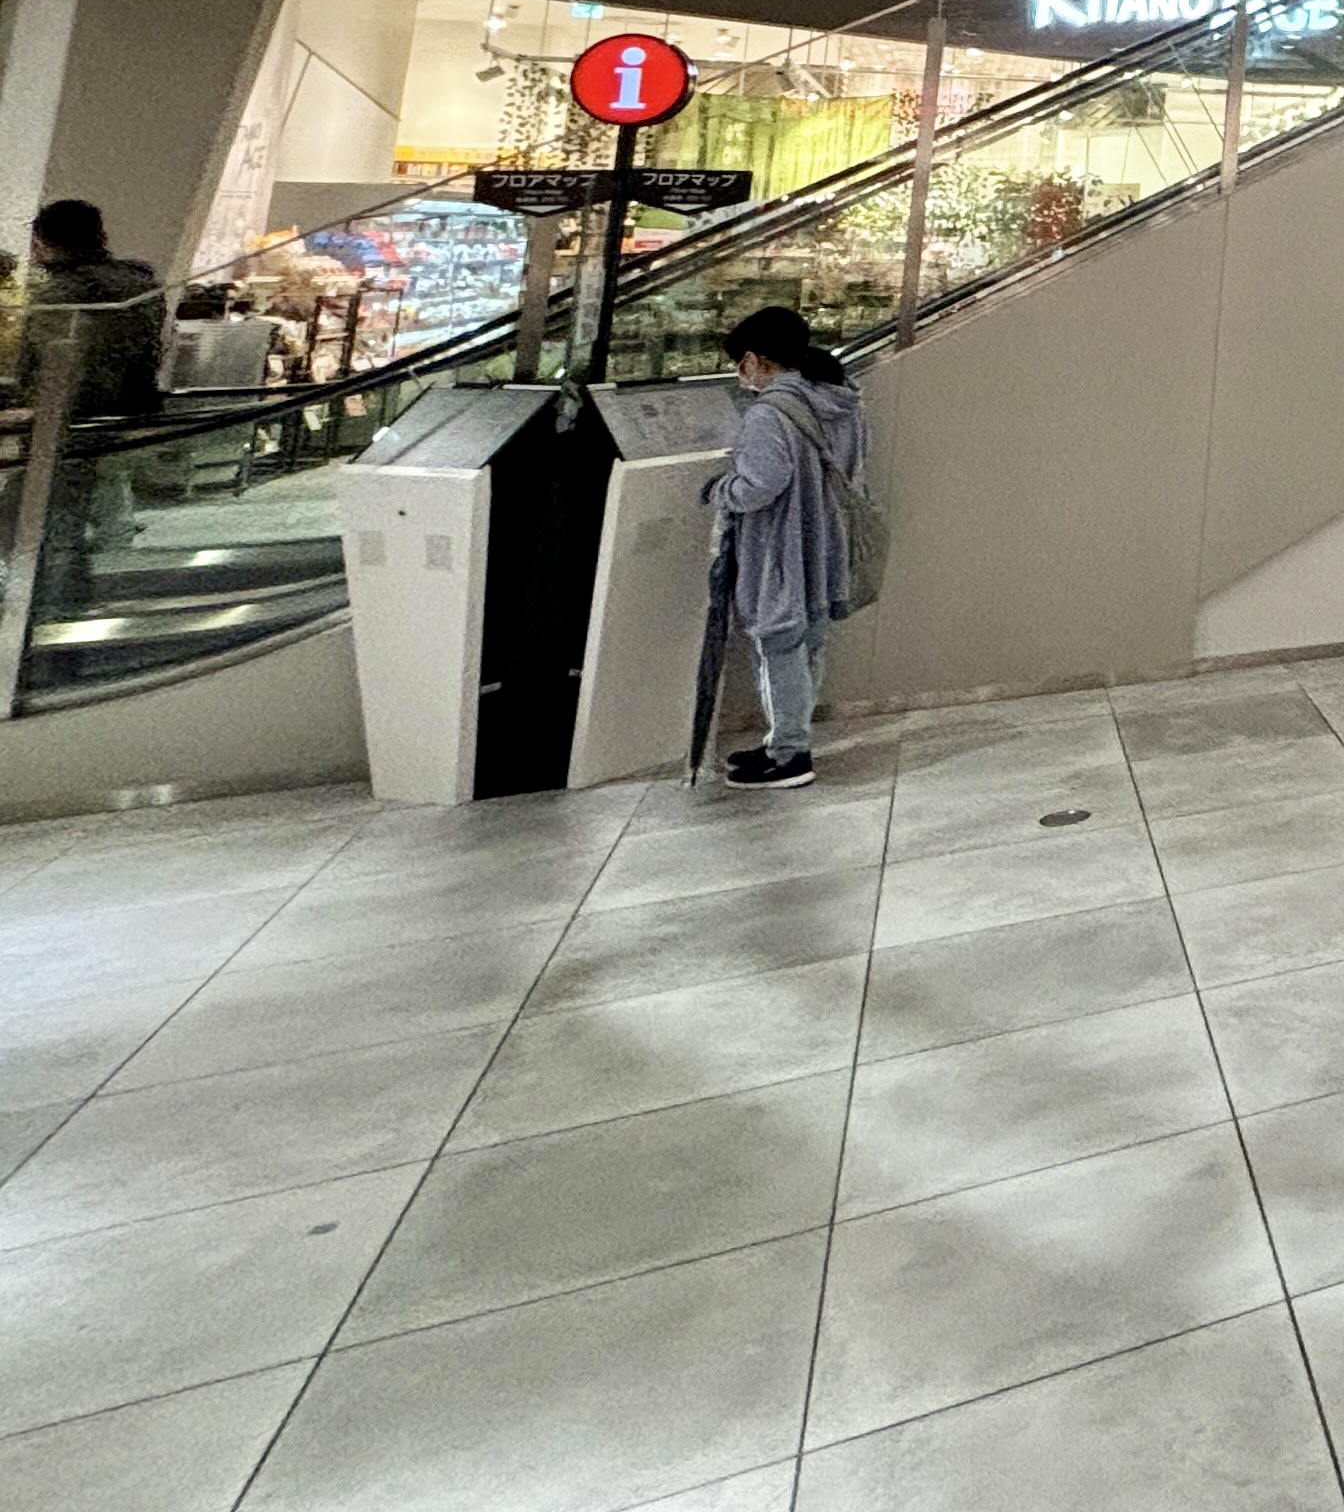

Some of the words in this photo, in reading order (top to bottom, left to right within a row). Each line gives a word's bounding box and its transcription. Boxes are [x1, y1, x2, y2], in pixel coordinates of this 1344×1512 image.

[492, 172, 598, 188] フロアマップ
[641, 172, 739, 187] フロアマップ
